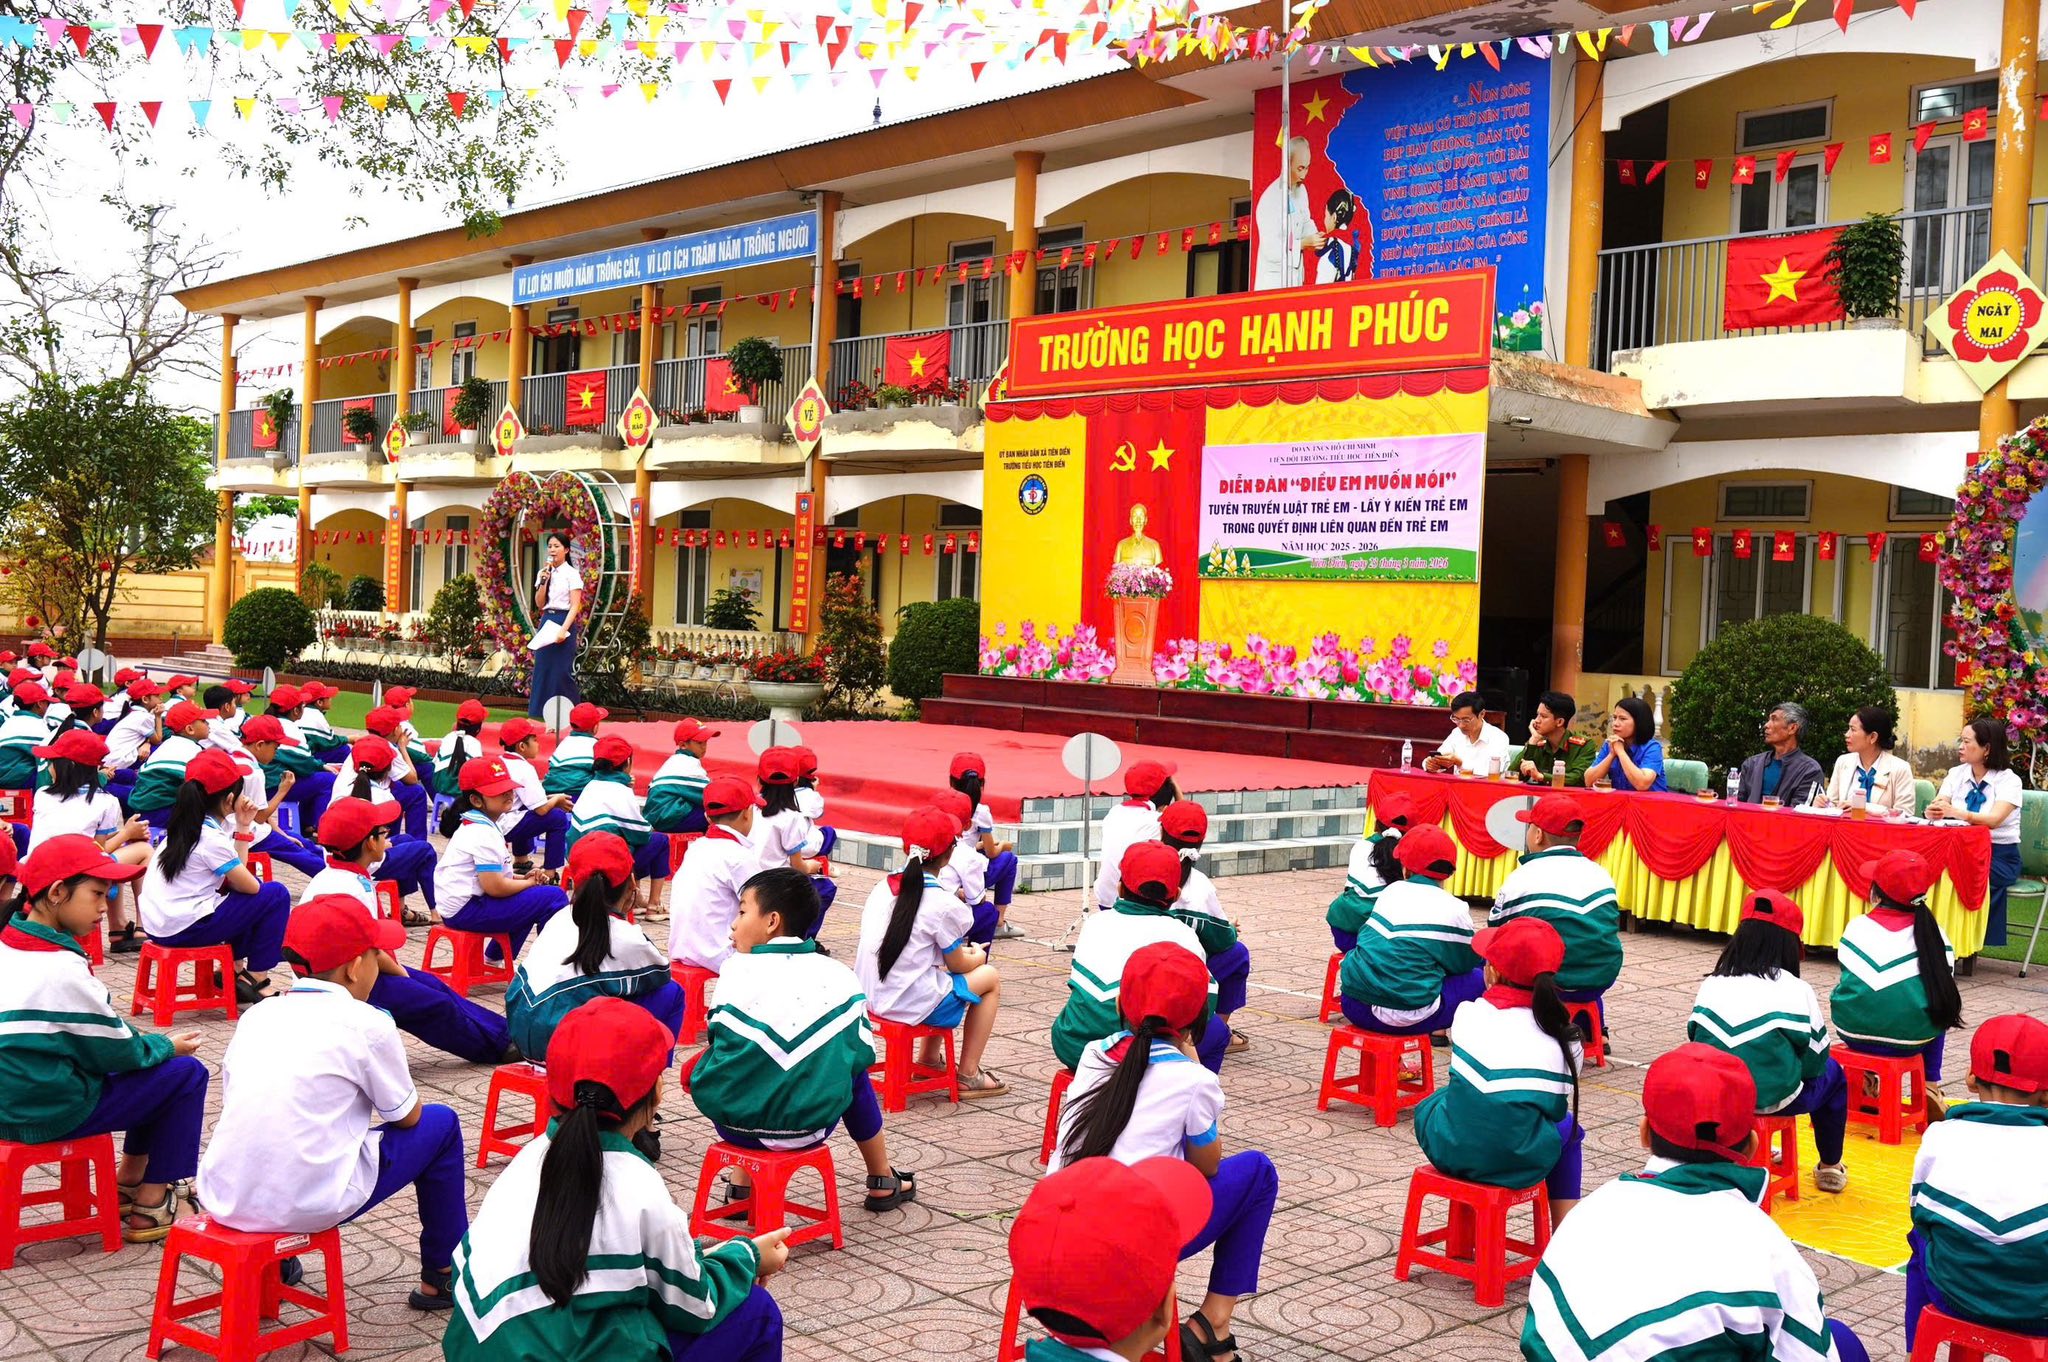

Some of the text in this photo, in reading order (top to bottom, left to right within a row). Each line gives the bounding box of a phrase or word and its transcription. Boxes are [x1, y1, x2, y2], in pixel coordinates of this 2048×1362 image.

[1500, 81, 1530, 100] SÔNG
[1384, 124, 1408, 142] VIỆT
[1410, 122, 1434, 136] NAM
[1454, 111, 1476, 128] TRỞ
[1478, 107, 1500, 124] NÊN
[1406, 144, 1428, 158] HAY
[1505, 122, 1530, 144] TỘC
[1384, 165, 1407, 182] VIỆT
[1408, 163, 1434, 176] NAM
[1383, 186, 1408, 200] VINH
[1409, 180, 1443, 198] QUANG
[1460, 172, 1488, 191] SÁNH
[1382, 204, 1402, 222] CÁC
[1499, 187, 1530, 204] CHÂU
[1412, 224, 1434, 237] HAY
[1477, 209, 1512, 229] CHÍNH
[1514, 206, 1528, 224] LÀ
[1402, 242, 1424, 260] MỘT
[1476, 234, 1497, 250] CỦA
[1499, 230, 1528, 246] CÔNG
[519, 274, 526, 296] VÌ
[528, 274, 539, 298] LỢI
[540, 270, 552, 294] ÍCH
[554, 264, 574, 290] MƯỜI
[575, 262, 594, 286] NĂM
[624, 254, 640, 278] CÂY,
[647, 248, 655, 274] VÌ
[657, 250, 671, 276] LỢI
[673, 246, 688, 270] ÍCH
[691, 240, 716, 266] TRĂM
[718, 236, 741, 262] NĂM
[744, 226, 776, 258] TRỒNG
[778, 220, 809, 252] NGƯỜI
[1977, 302, 2012, 316] NGÀY
[1038, 289, 1450, 373] TRƯỜNG HỌC HẠNH PHÚC
[1980, 326, 2003, 338] MAI
[504, 429, 511, 439] EM
[1219, 474, 1252, 494] DIỄN
[1255, 475, 1288, 492] ĐÀN
[1340, 475, 1362, 490] EM
[1365, 468, 1412, 490] MUỐN
[1209, 502, 1239, 515] TUYÊN
[1283, 500, 1308, 516] LUẬT
[1311, 498, 1330, 514] TRẺ
[1334, 501, 1350, 513] EM
[1361, 497, 1380, 513] LẤY
[1385, 498, 1391, 512] Ý
[1394, 496, 1421, 512] KIẾN
[1425, 496, 1445, 511] TRẺ
[1450, 499, 1468, 511] EM
[1223, 516, 1448, 535] TRONG QUYẾT ĐỊNH LIÊN QUAN ĐẾN TRẺ EM
[1282, 541, 1303, 551] NĂM
[1306, 542, 1328, 553] HỌC
[1331, 542, 1350, 551] 2025
[1360, 542, 1379, 551] 2026
[1380, 557, 1402, 570] tháng
[1409, 557, 1427, 568] năm
[1429, 557, 1449, 568] 2026
